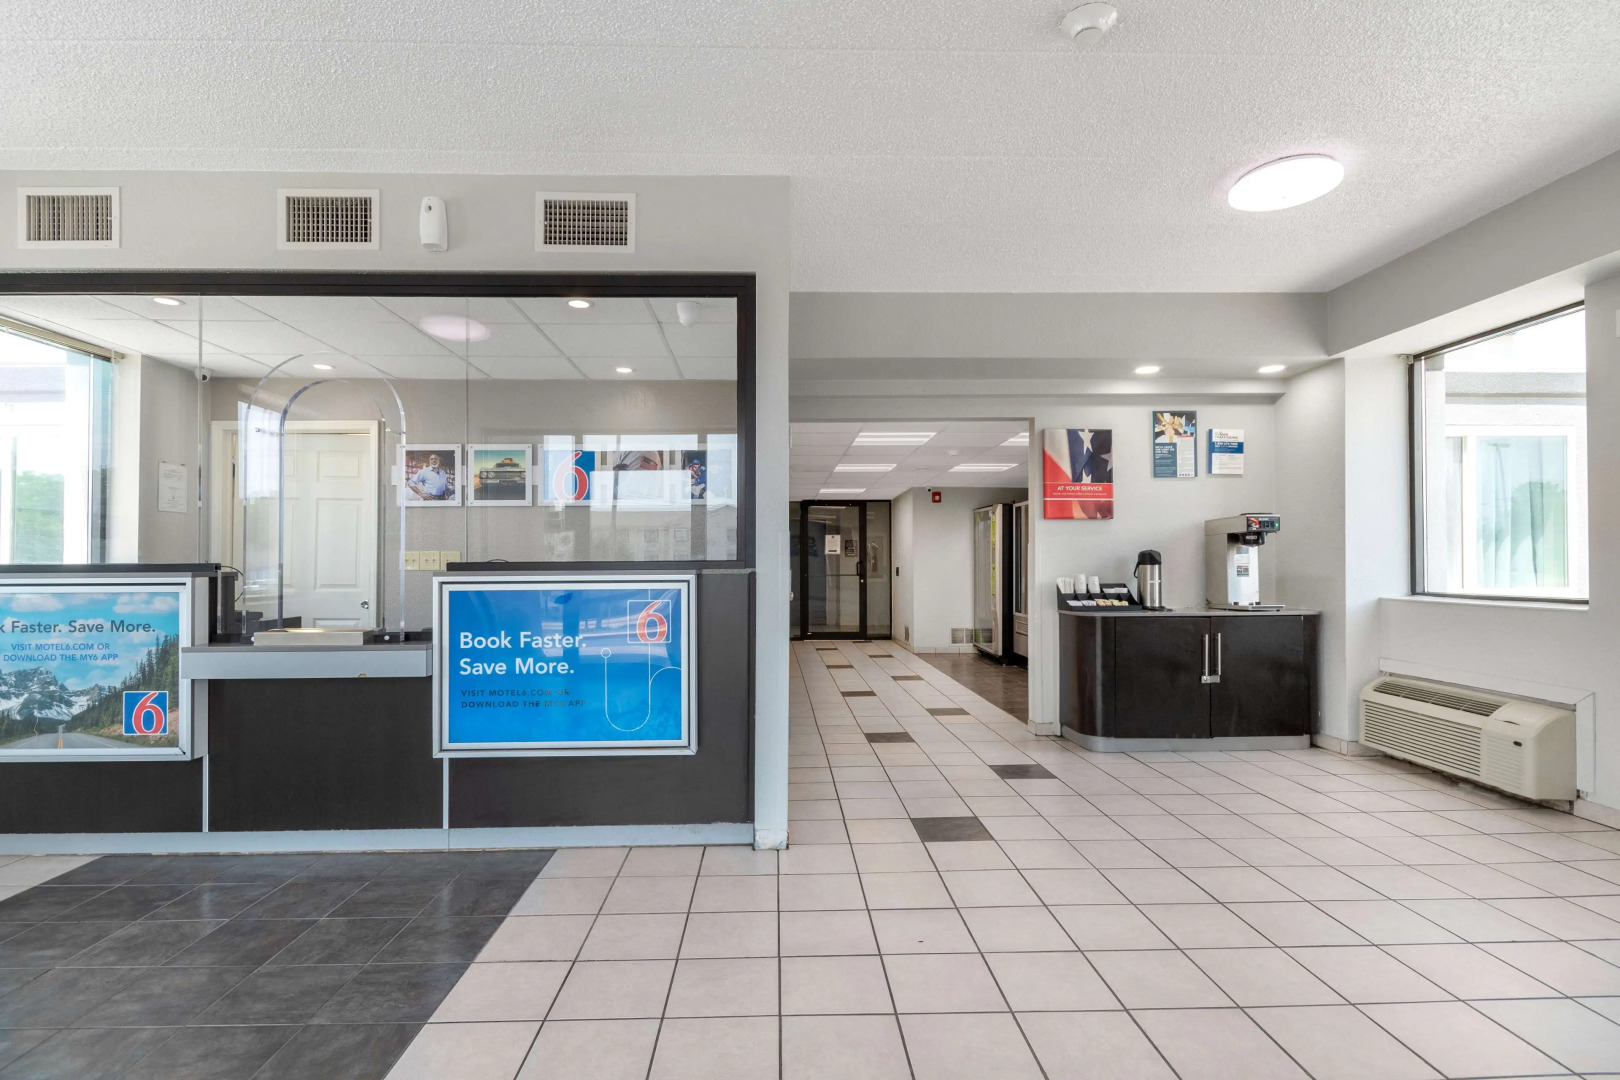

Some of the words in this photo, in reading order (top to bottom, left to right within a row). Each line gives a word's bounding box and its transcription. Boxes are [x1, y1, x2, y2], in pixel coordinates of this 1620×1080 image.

[552, 450, 590, 501] 6
[11, 620, 62, 633] Faster.
[68, 620, 104, 633] Save
[110, 619, 156, 633] More.
[636, 600, 668, 643] 6
[11, 643, 32, 651] VISIT
[35, 643, 94, 651] MOTEL6.COM
[459, 631, 512, 649] Book
[519, 631, 587, 648] Faster.
[3, 654, 57, 662] DOWNLOAD
[59, 653, 77, 661] THE
[80, 653, 98, 661] MY6
[100, 653, 119, 661] APP
[459, 657, 507, 675] Save
[515, 657, 575, 675] More.
[461, 689, 485, 697] VISIT
[489, 689, 553, 697] MOTEL6.COM
[556, 688, 570, 696] OR
[461, 700, 519, 708] DOWNLOAD
[523, 700, 540, 708] THE
[132, 691, 165, 735] 6
